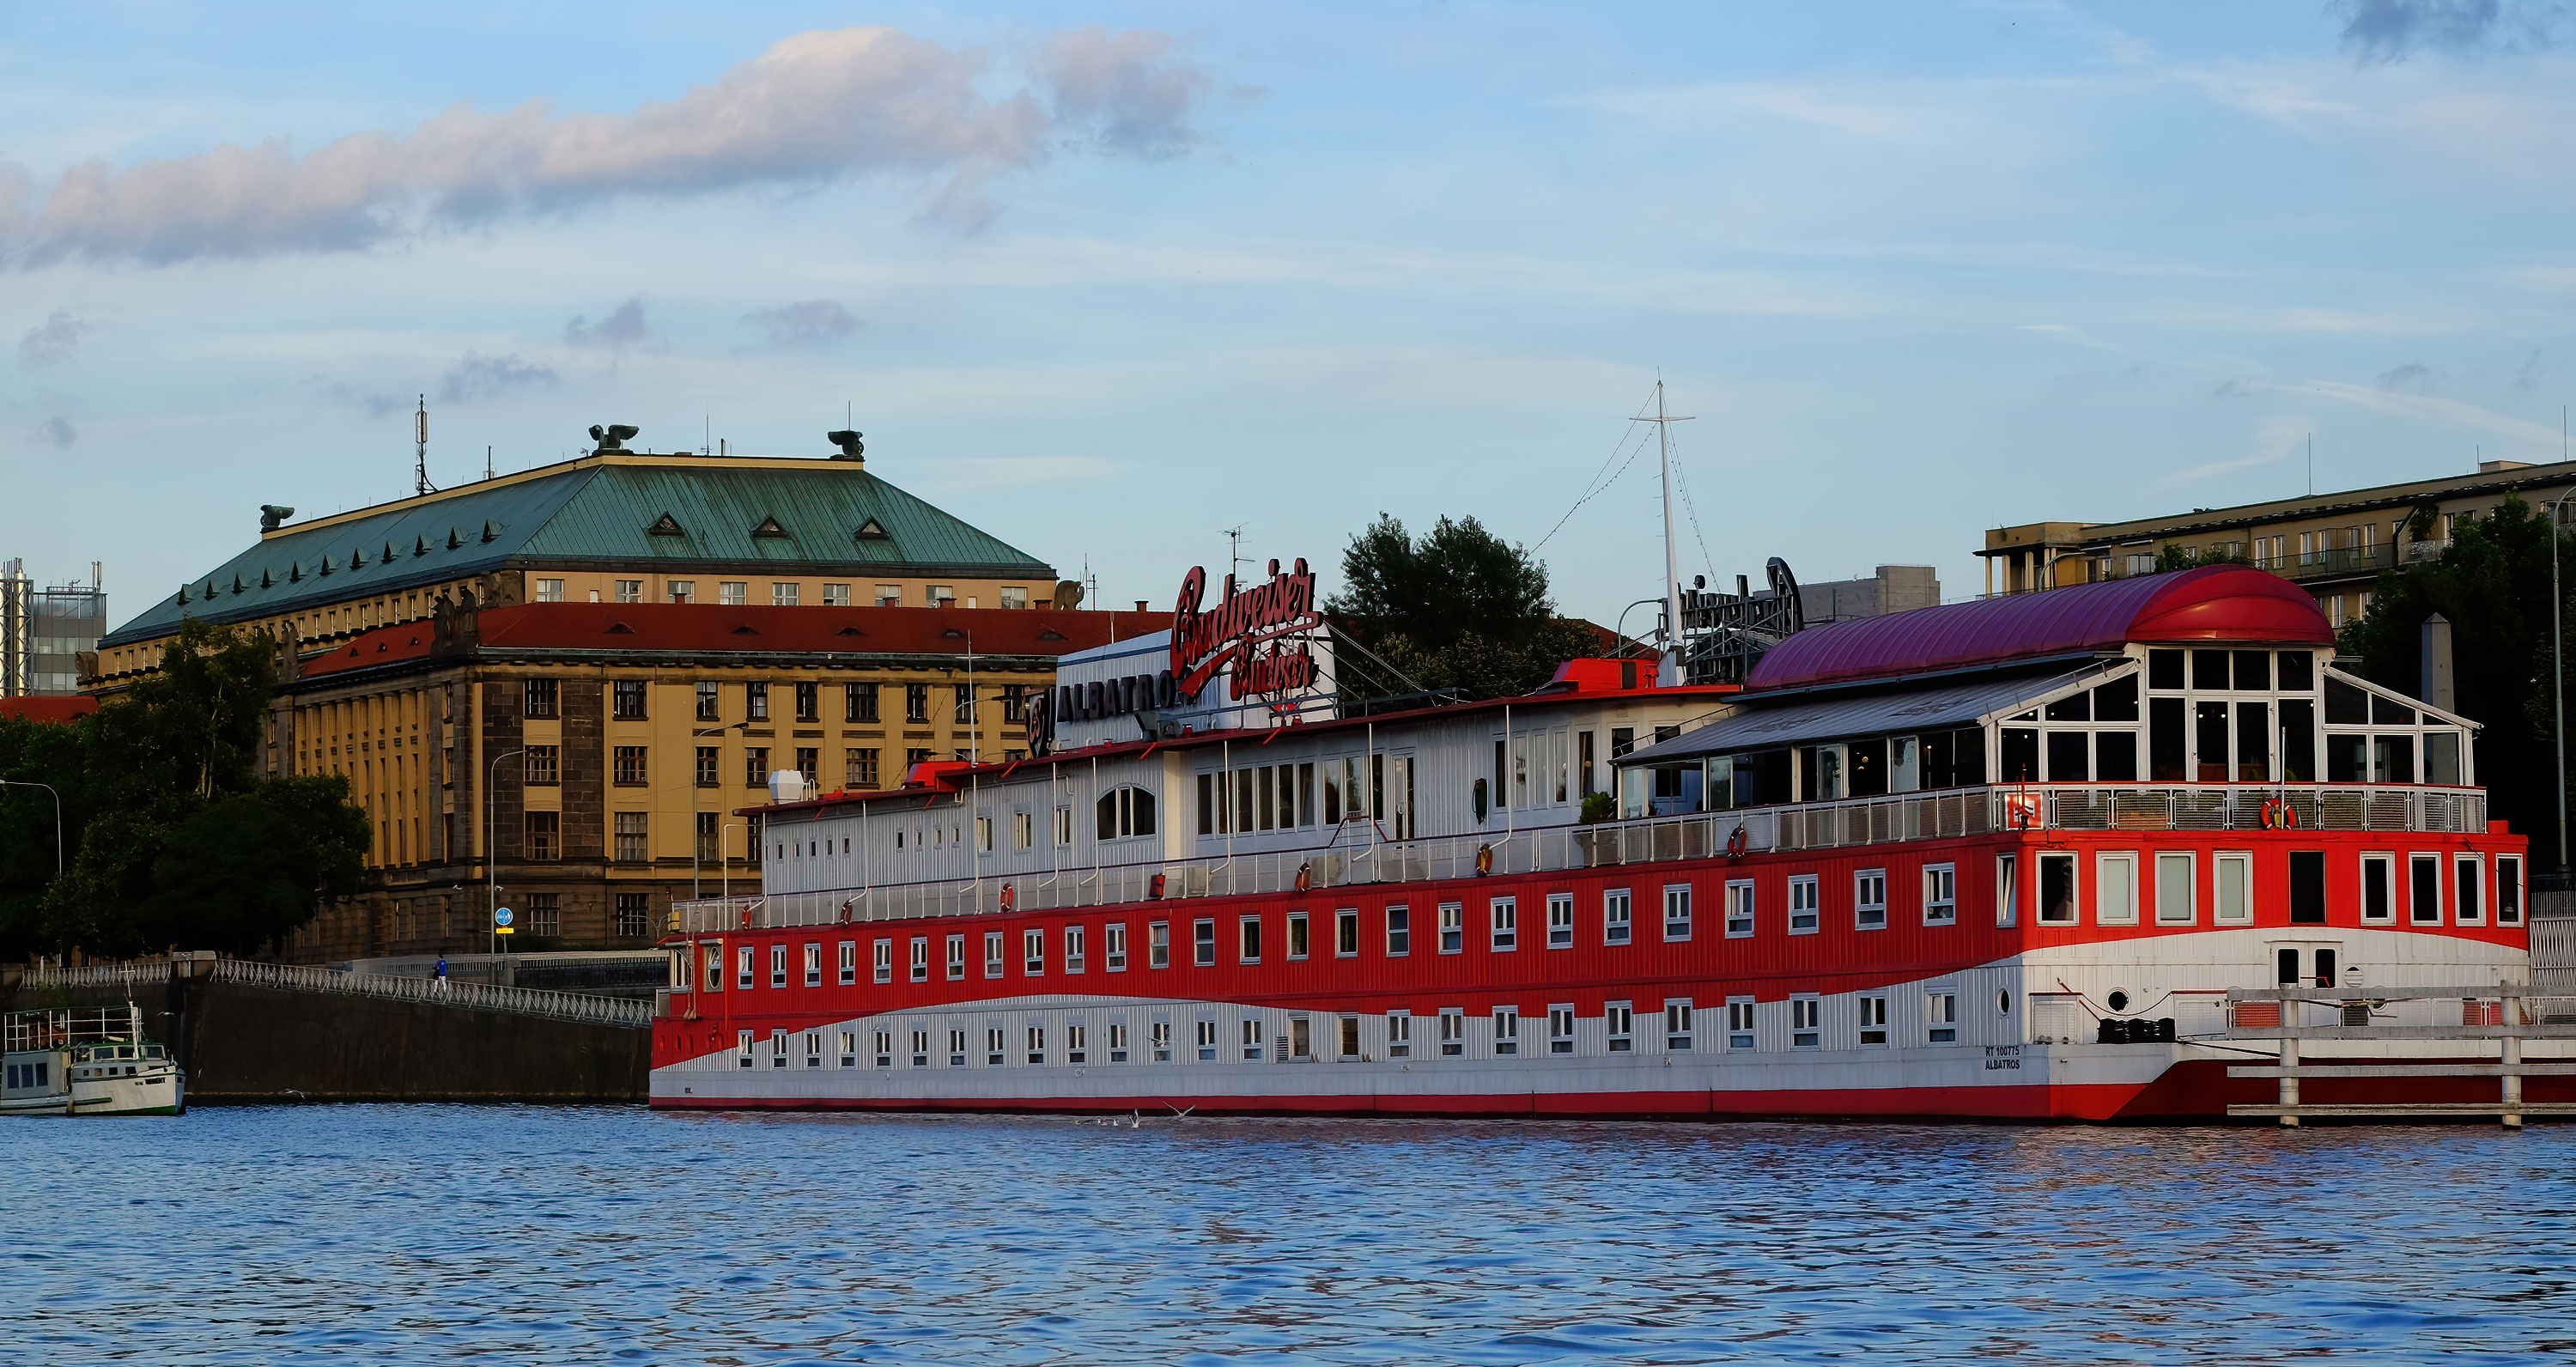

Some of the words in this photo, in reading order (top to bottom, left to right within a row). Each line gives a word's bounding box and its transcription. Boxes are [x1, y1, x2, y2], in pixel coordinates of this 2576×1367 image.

[1170, 557, 1323, 680] Budweiser
[1985, 1047, 1995, 1057] RT
[1996, 1046, 2020, 1057] 100775
[1985, 1059, 2020, 1071] ALBATROS
